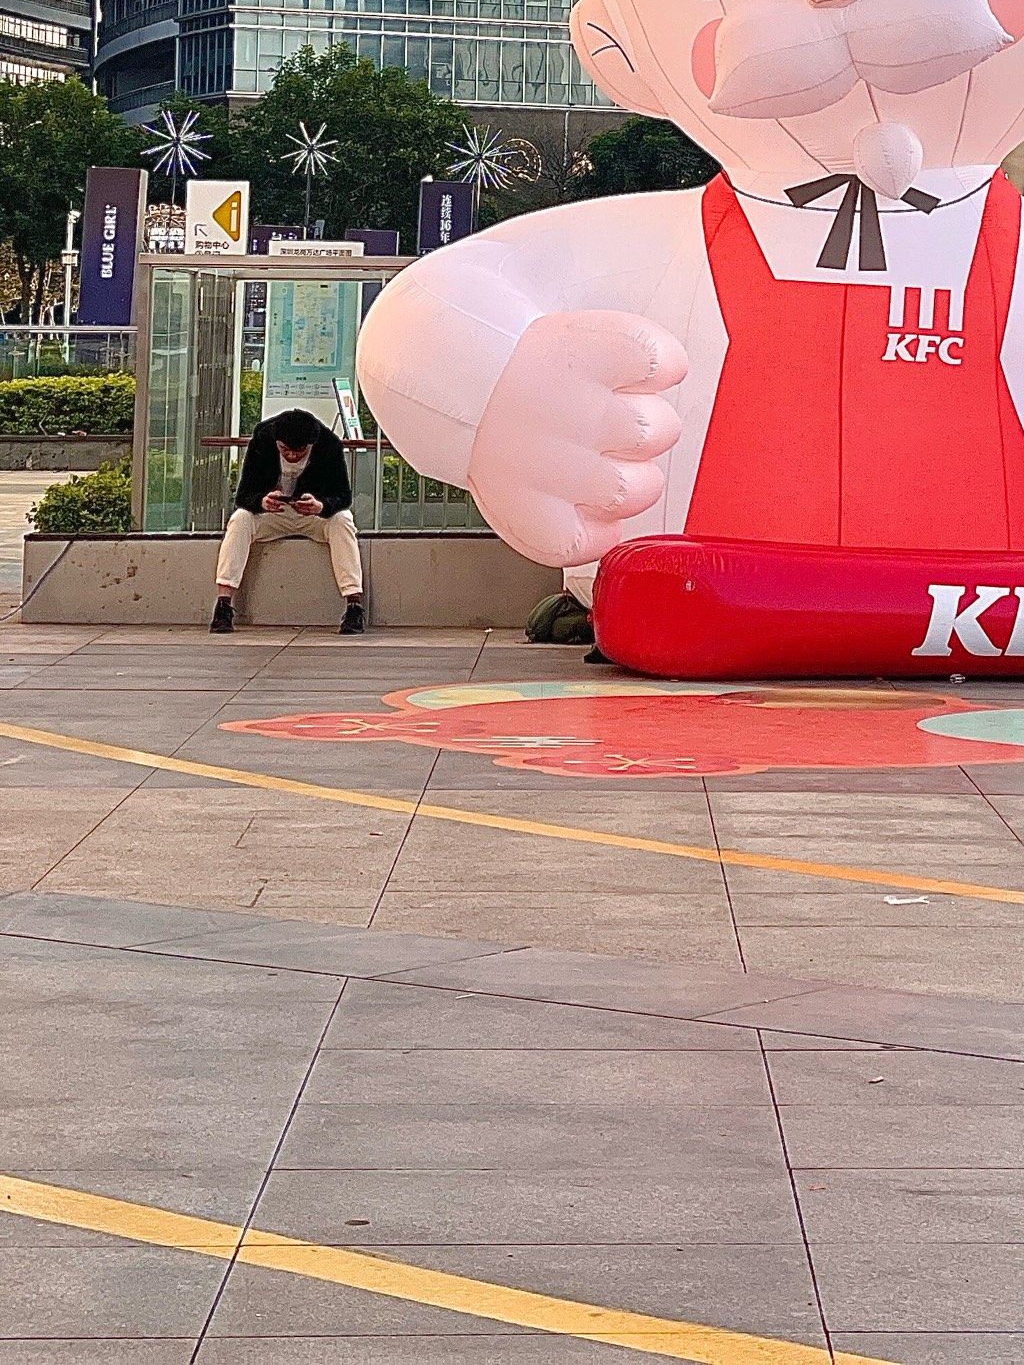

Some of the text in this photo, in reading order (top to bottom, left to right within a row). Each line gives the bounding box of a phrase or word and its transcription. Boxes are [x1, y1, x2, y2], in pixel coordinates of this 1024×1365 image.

[101, 206, 117, 278] BLUE GIRL
[194, 240, 230, 250] 购物中心
[881, 333, 965, 365] KFC
